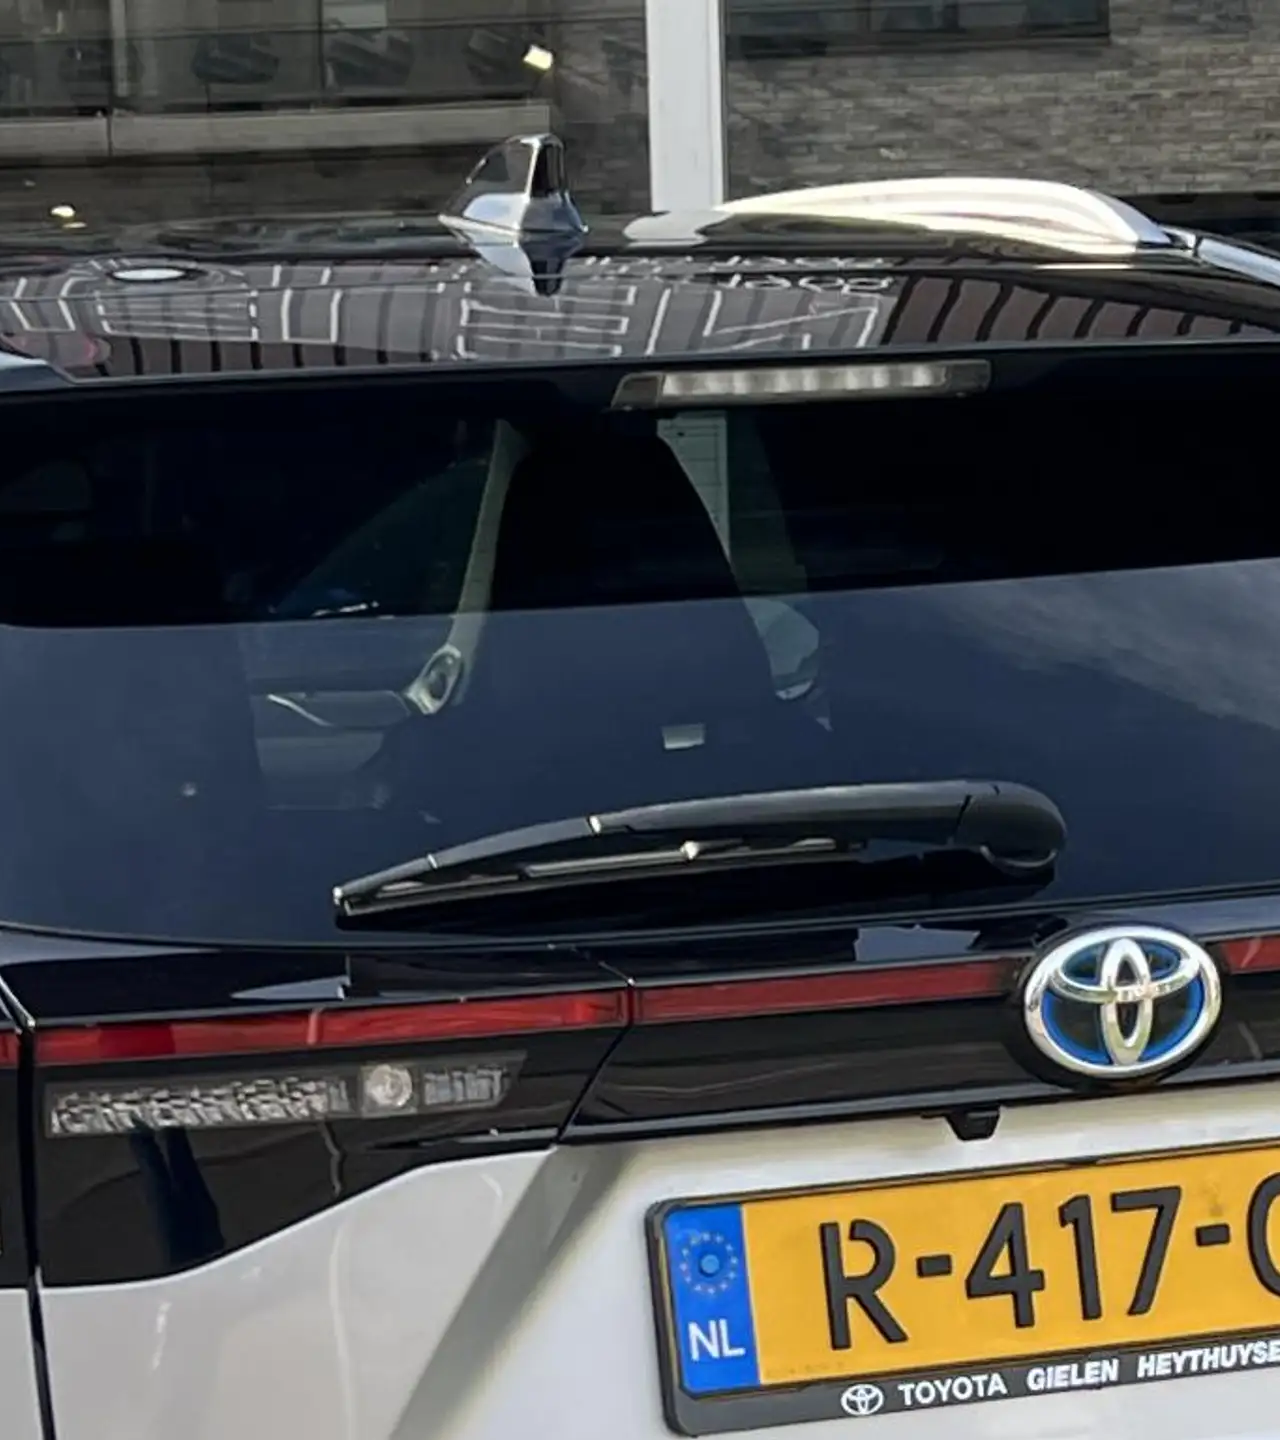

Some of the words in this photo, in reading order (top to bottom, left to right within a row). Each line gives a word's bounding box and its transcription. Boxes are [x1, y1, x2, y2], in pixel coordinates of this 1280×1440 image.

[687, 1318, 746, 1362] NL
[898, 1372, 1007, 1406] TOYOTA
[1026, 1358, 1119, 1391] GIELEN
